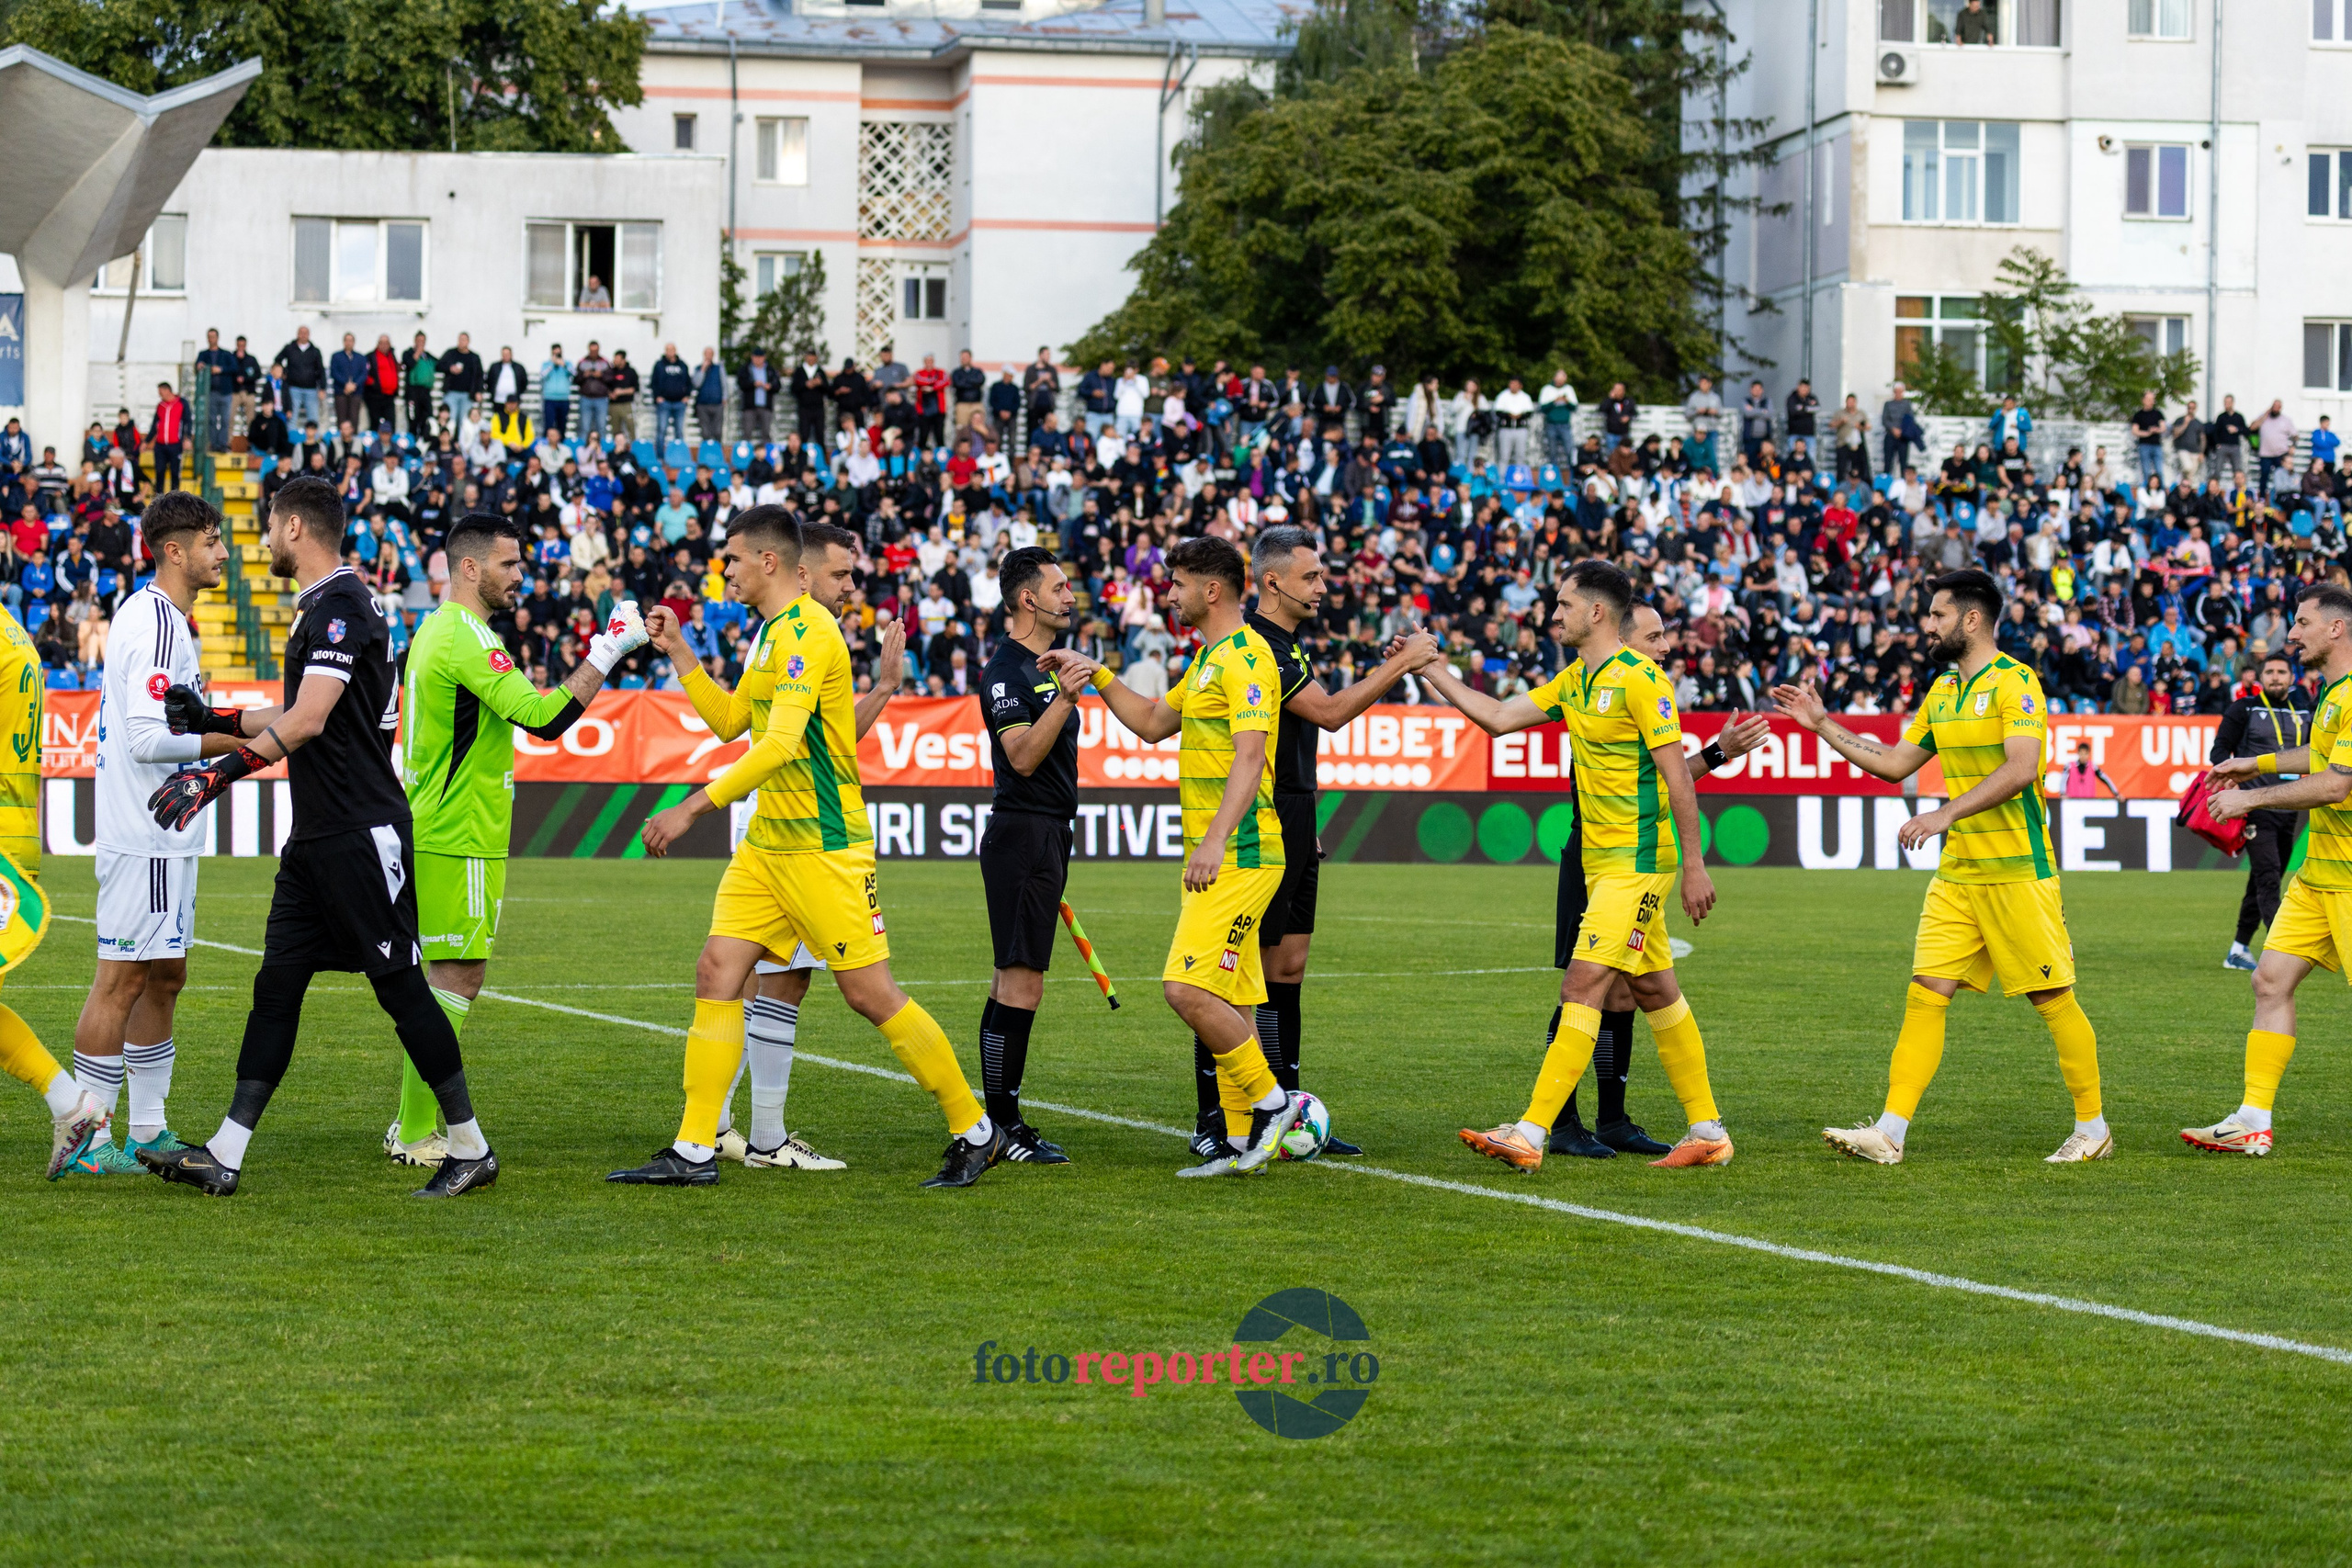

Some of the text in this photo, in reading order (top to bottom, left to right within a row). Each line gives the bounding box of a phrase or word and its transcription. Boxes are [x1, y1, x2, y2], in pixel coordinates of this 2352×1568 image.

[311, 649, 354, 665] MIOVENI
[775, 682, 811, 695] MIOVENI
[1317, 715, 1465, 759] NIBET
[118, 938, 135, 946] Eco
[447, 933, 464, 942] Eco
